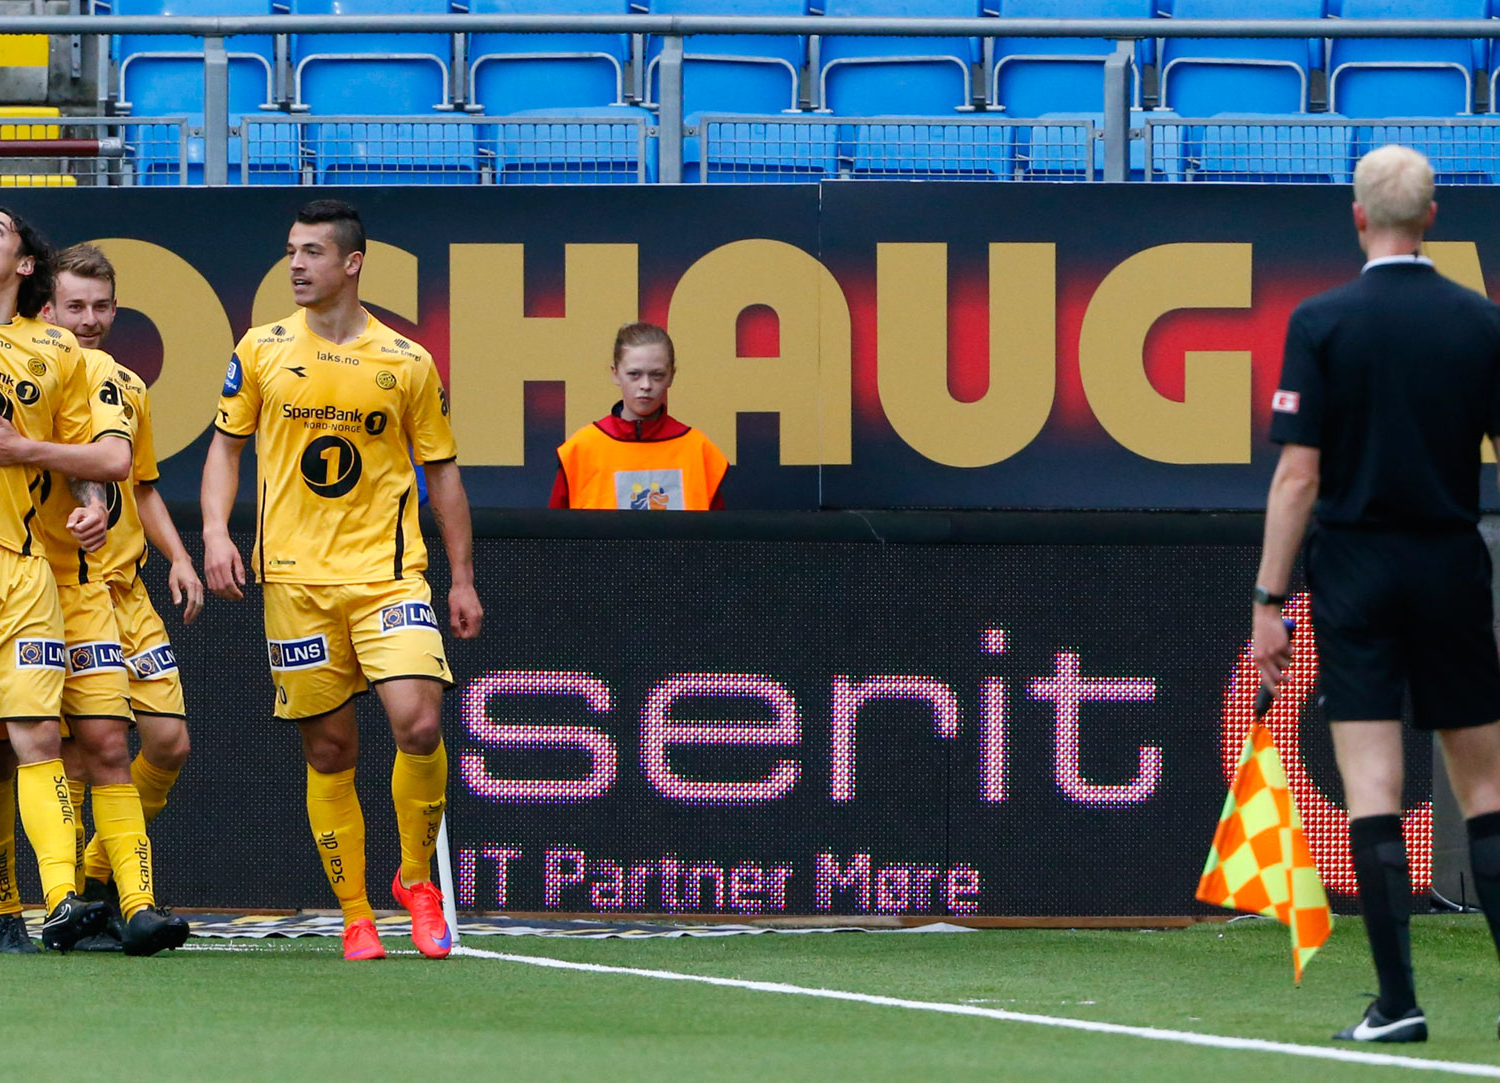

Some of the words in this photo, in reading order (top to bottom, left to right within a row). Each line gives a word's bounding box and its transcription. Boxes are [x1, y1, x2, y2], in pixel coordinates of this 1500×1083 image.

[316, 351, 360, 366] laks.no
[283, 403, 363, 423] SpareBank
[304, 421, 361, 433] NORD-NORGE
[285, 643, 321, 662] LNS
[460, 622, 1164, 807] serit
[135, 839, 151, 892] Scandic
[319, 830, 346, 884] Scadic
[459, 845, 524, 906] IT
[544, 846, 793, 913] Partner
